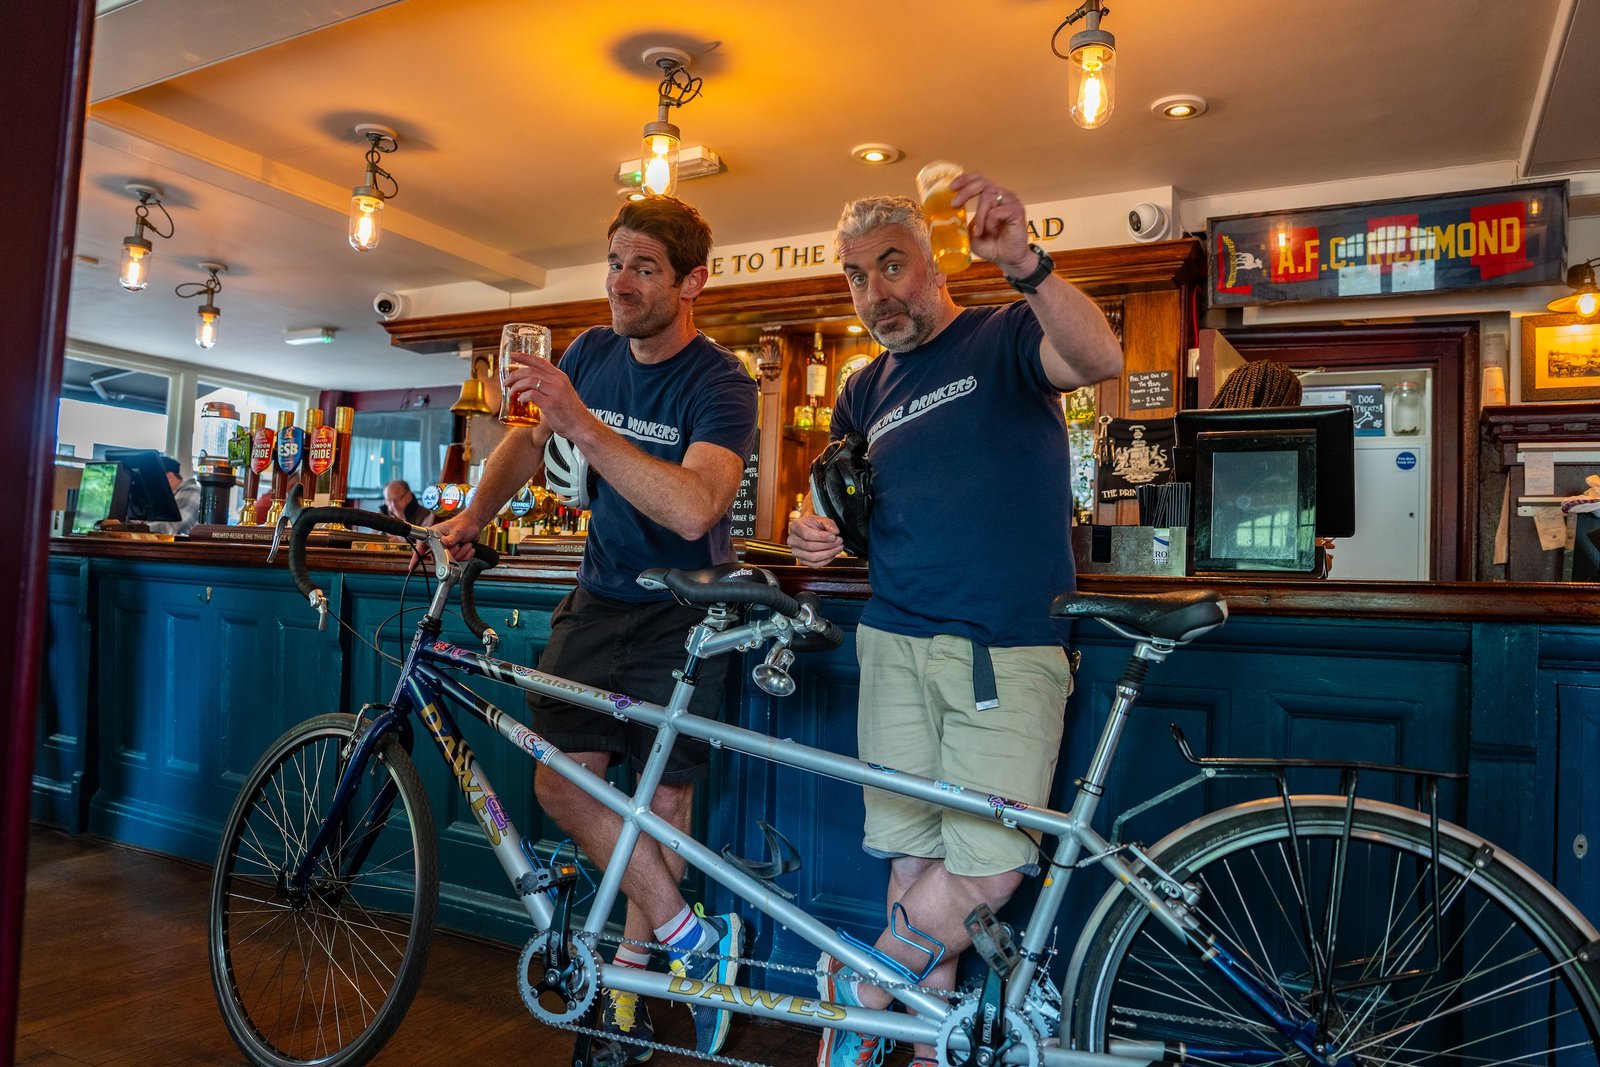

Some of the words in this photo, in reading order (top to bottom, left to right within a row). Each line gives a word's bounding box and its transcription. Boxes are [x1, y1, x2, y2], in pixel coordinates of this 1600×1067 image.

[732, 253, 764, 274] TO
[771, 245, 825, 271] THE
[1026, 217, 1064, 241] AD
[908, 376, 975, 414] DRINKERS
[1358, 395, 1374, 404] DOG
[1355, 404, 1383, 413] TREATS!
[627, 416, 679, 441] DRINKERS
[252, 449, 269, 459] PRIDE
[279, 443, 298, 457] ESB
[310, 449, 331, 459] PRIDE
[1102, 488, 1117, 499] THE
[1119, 488, 1136, 497] PRIN
[530, 674, 588, 695] Galaxy
[421, 703, 507, 846] DAWES
[667, 976, 847, 1021] DAWES
